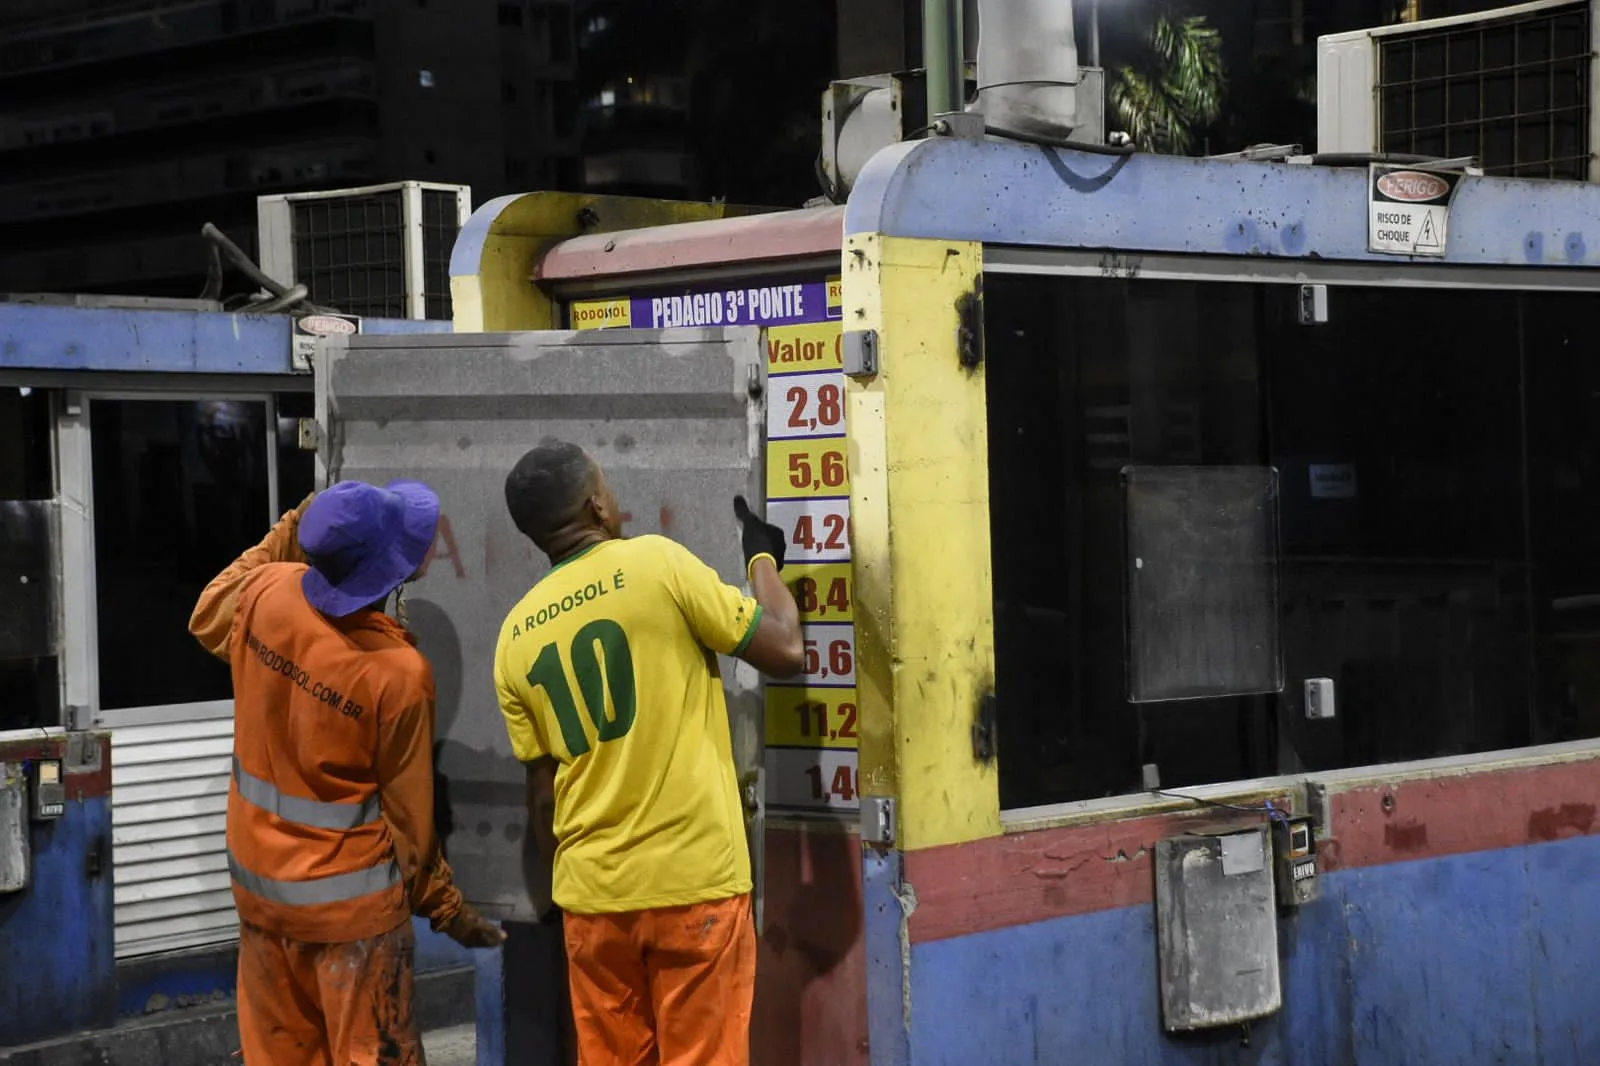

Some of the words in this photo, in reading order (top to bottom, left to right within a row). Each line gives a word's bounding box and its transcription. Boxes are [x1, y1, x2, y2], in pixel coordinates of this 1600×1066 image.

[1387, 178, 1438, 195] PERIGO
[1377, 212, 1400, 224] RISCO
[1401, 214, 1412, 224] DE
[1377, 229, 1410, 242] CHOQUE
[652, 289, 723, 328] PEDÁGIO
[748, 284, 803, 321] PONTE
[768, 338, 825, 364] Valor
[786, 384, 846, 431] 2,8
[789, 451, 849, 490] 5,6
[792, 514, 850, 553] 4,2
[513, 624, 521, 641] A
[525, 580, 608, 632] RODOSOL
[613, 568, 625, 591] É
[798, 577, 854, 615] 8,4
[526, 618, 637, 758] 10
[806, 765, 860, 803] 1,4
